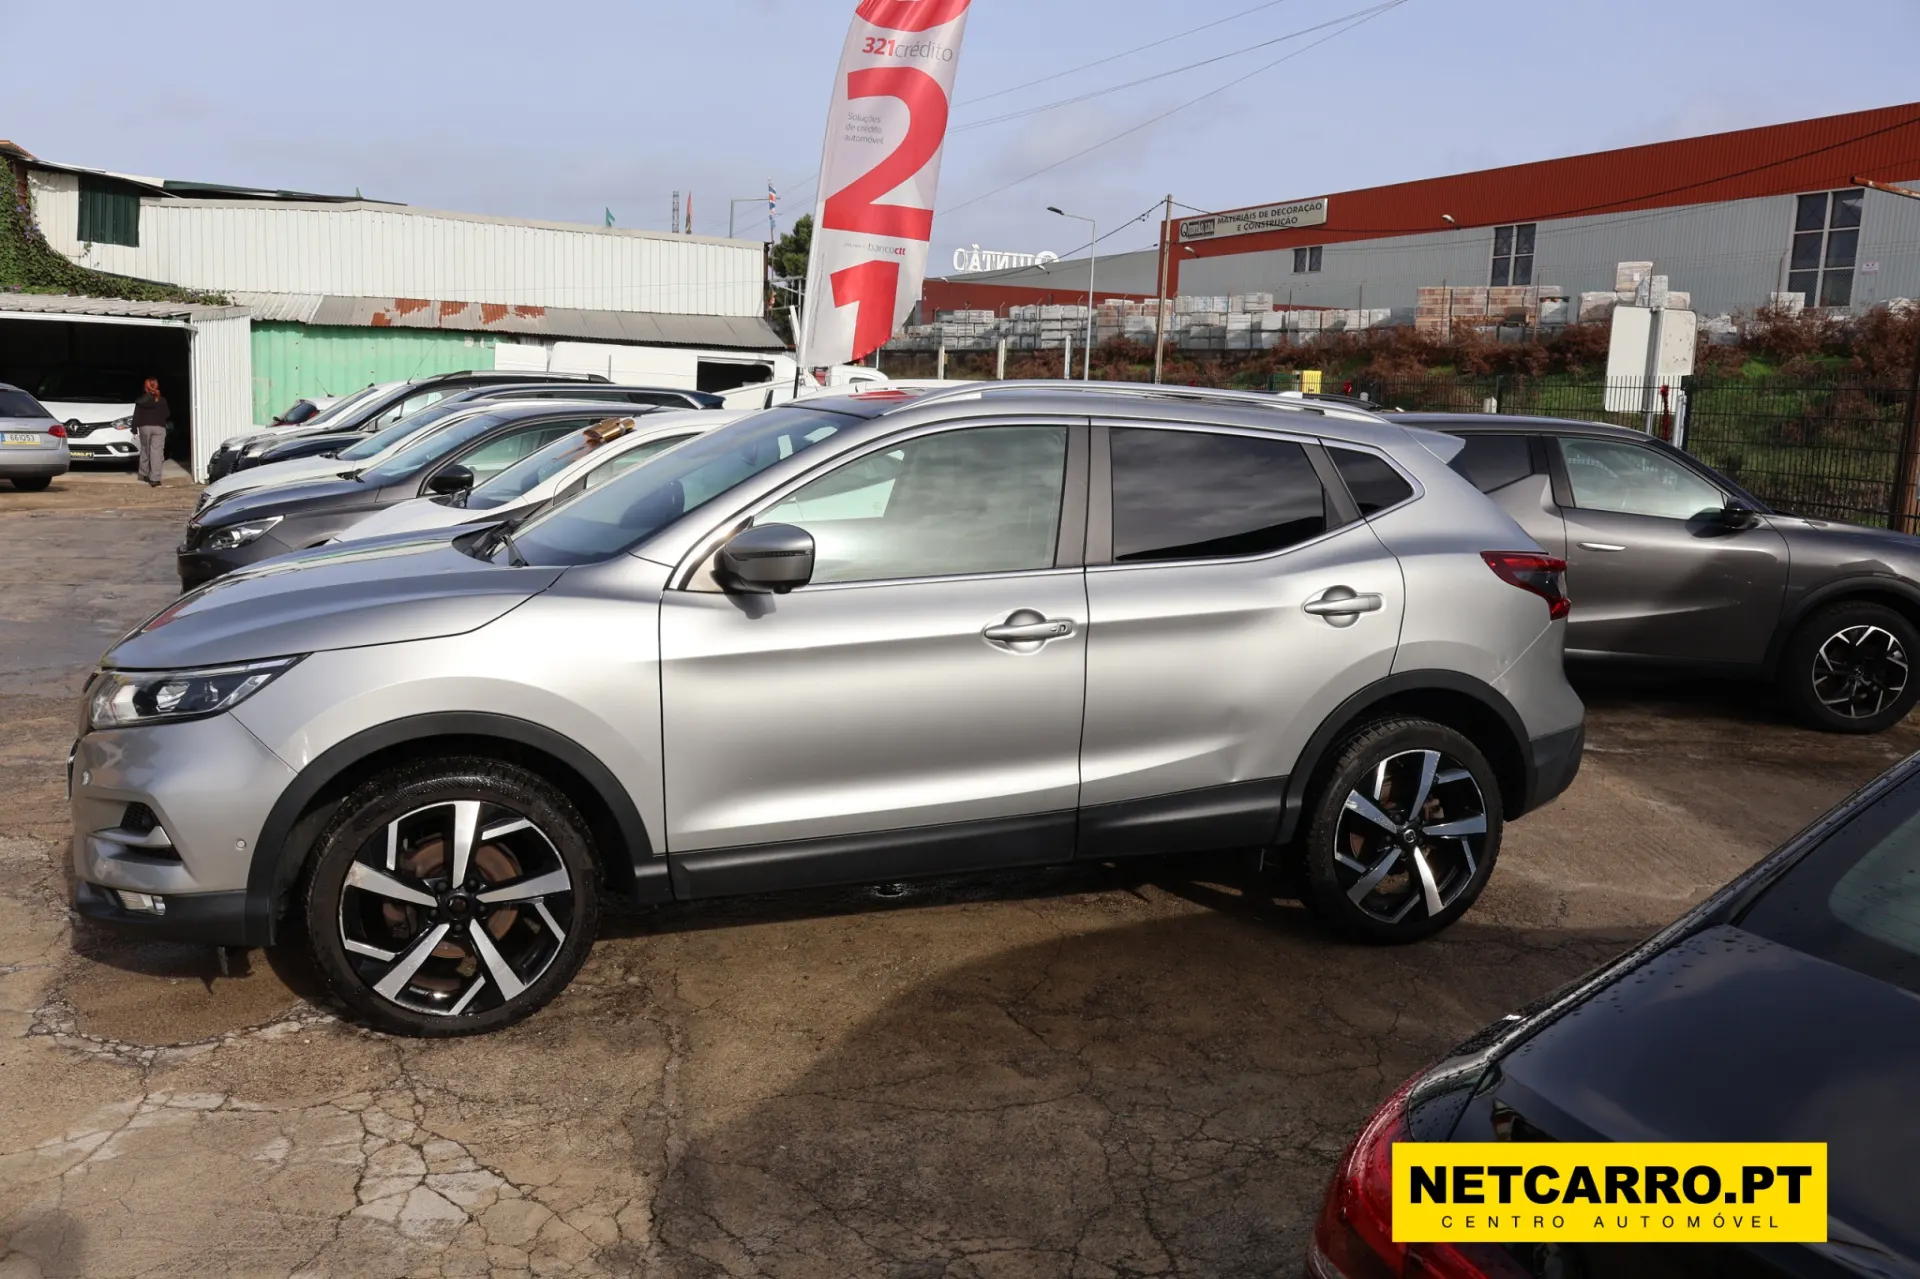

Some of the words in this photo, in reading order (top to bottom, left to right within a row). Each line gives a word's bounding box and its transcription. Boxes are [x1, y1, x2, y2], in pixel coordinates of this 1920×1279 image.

[862, 37, 953, 62] 321crédito
[1217, 211, 1257, 225] MATERIAIS
[1258, 210, 1269, 219] DE
[1270, 202, 1323, 217] DECORAÇÃO
[1243, 216, 1299, 231] CONSTRUÇÃO
